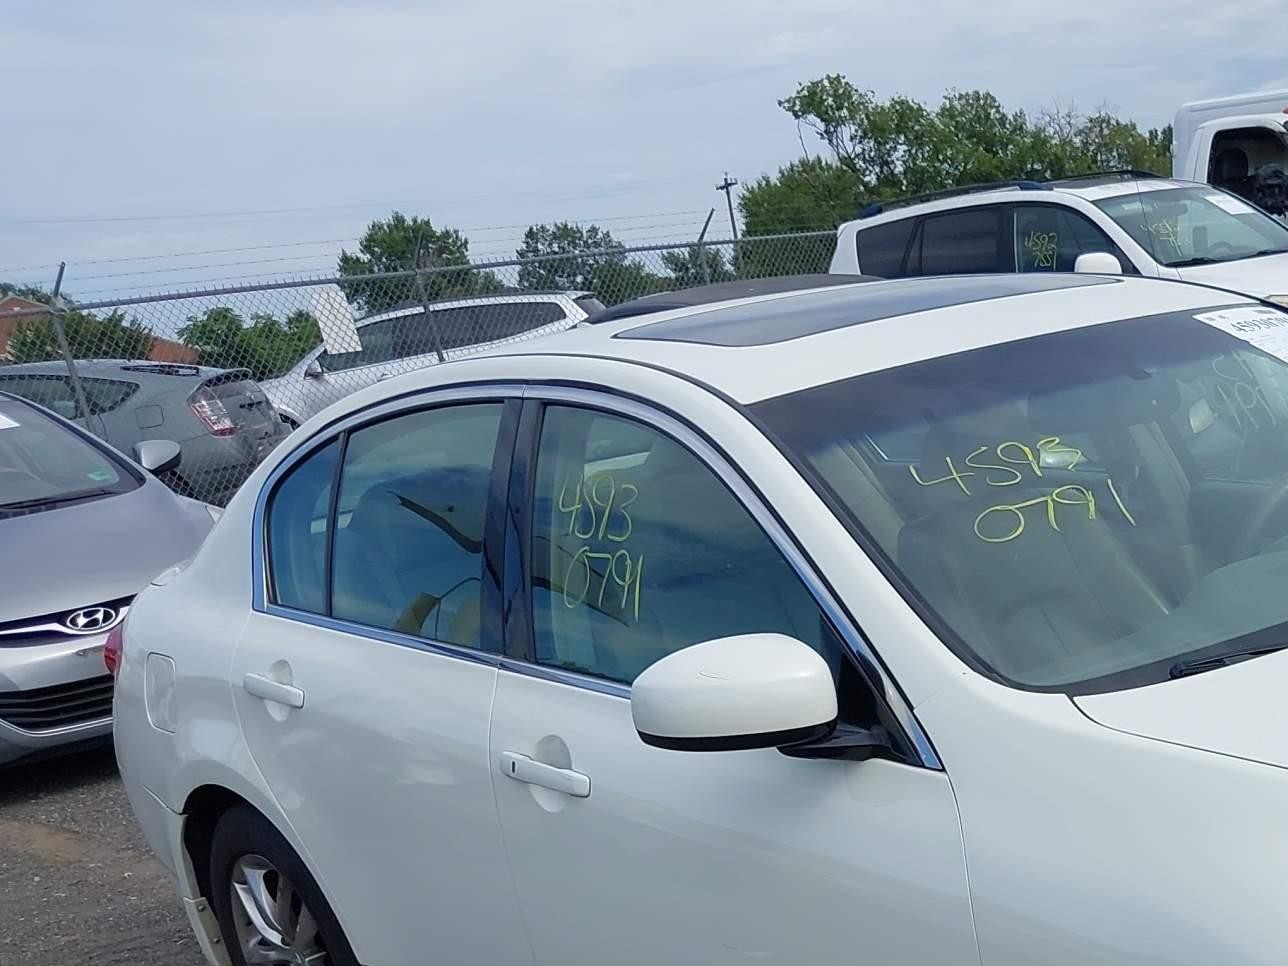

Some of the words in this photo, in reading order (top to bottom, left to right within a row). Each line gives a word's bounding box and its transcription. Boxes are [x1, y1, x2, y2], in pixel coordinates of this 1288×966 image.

[909, 436, 1083, 496] 4593
[558, 474, 639, 542] 4593
[973, 478, 1137, 543] 0791
[563, 546, 644, 623] 0791
